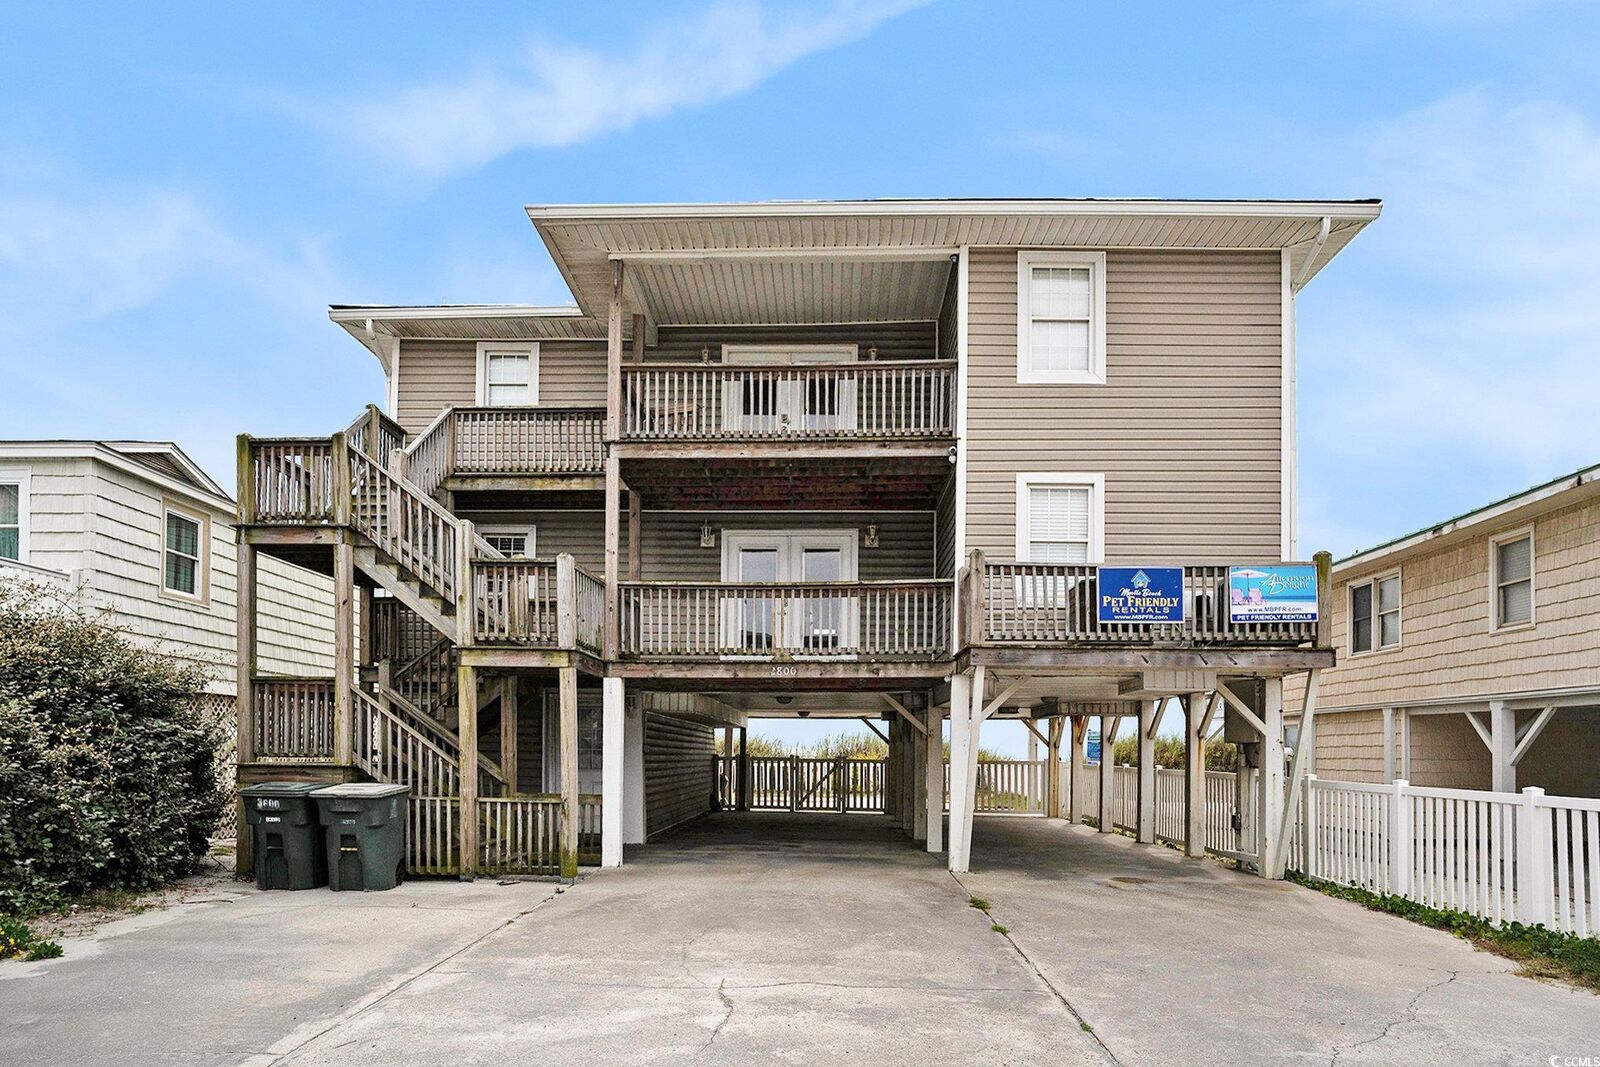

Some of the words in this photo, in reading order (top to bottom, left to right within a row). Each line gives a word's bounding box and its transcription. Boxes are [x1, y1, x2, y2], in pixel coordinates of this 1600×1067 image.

[1142, 588, 1162, 597] Beach
[1103, 596, 1124, 607] PET
[1127, 595, 1179, 607] FRIENDLY
